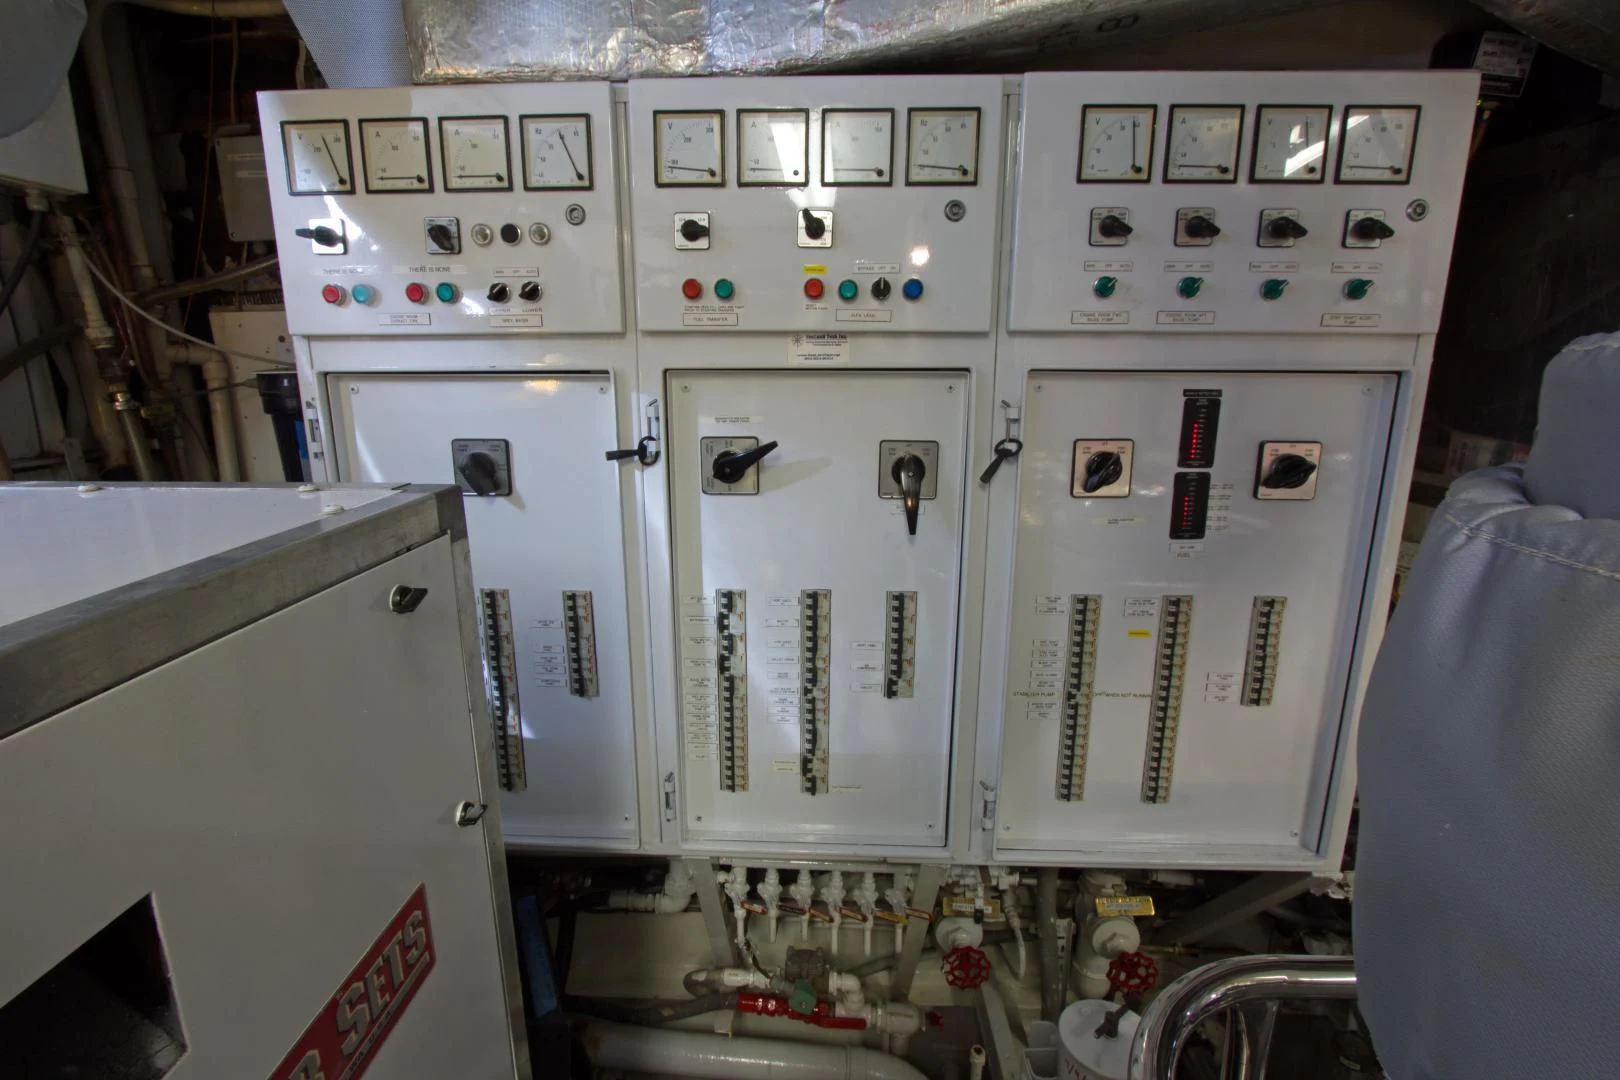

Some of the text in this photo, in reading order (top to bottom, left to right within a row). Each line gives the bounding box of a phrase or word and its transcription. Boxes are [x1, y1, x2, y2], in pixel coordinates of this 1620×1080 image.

[667, 122, 672, 131] V
[1095, 118, 1100, 126] V
[335, 909, 427, 1057] SETS
